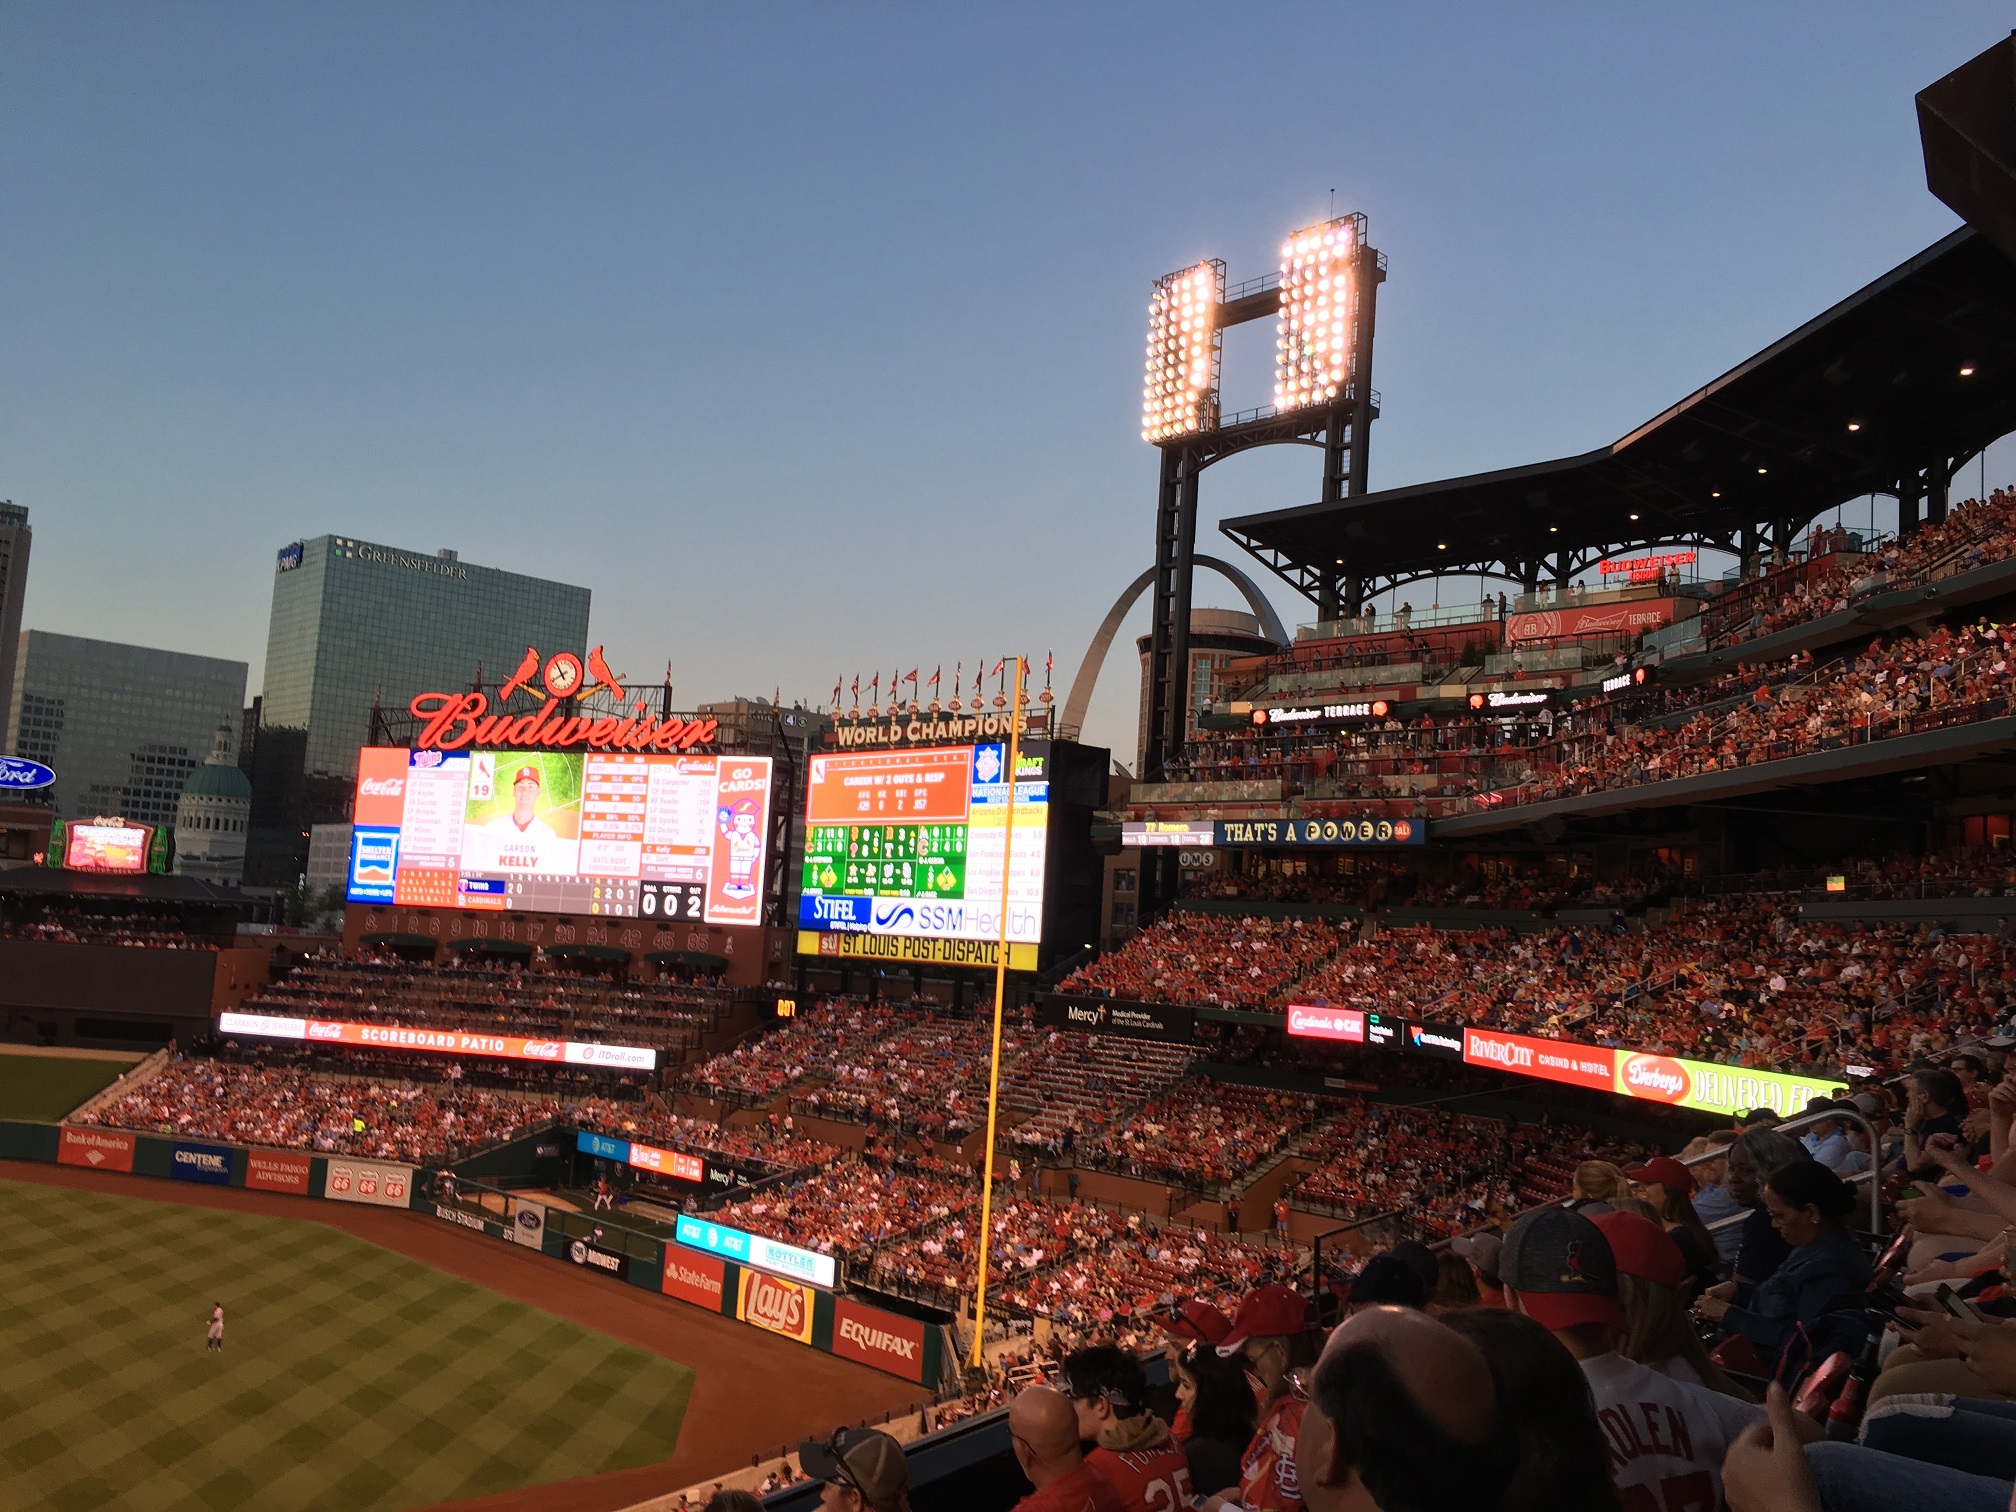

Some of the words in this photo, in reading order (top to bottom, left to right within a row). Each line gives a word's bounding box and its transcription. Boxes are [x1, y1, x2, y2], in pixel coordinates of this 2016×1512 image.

[1599, 551, 1696, 575] BUDWEISER
[1629, 611, 1661, 626] TERRACE
[1604, 672, 1631, 693] TERRACE
[1487, 691, 1548, 708] Budweiser
[1269, 706, 1322, 723] Budweiser
[1324, 703, 1370, 719] TERRACE
[409, 692, 718, 750] Budweiser
[838, 726, 902, 746] WORLD
[906, 715, 1028, 742] CHAMPIONS
[414, 750, 442, 768] Twins
[675, 757, 716, 774] Cardinals
[732, 768, 752, 779] GO
[1016, 766, 1043, 776] KINGS
[662, 779, 690, 787] Carpenter
[719, 779, 767, 793] CARDS!
[844, 776, 872, 786] CAREER
[874, 775, 884, 785] W/
[886, 775, 892, 784] 2
[893, 774, 914, 784] OUTS
[916, 774, 922, 783] &
[925, 773, 945, 783] RISP
[474, 784, 490, 796] 19
[858, 790, 870, 799] AVG
[914, 789, 927, 797] OPS
[972, 787, 1007, 797] NATIONA
[1014, 785, 1046, 796] LEAGUE
[857, 801, 870, 811] .429
[971, 807, 995, 816] Arizona
[997, 806, 1044, 816] Diaondbacks
[826, 828, 834, 838] 11
[1158, 822, 1190, 832] Romero
[1224, 822, 1277, 842] THAT'S
[1285, 823, 1297, 842] A
[1306, 822, 1391, 841] POWER
[970, 831, 996, 839] Colorado
[1032, 831, 1042, 839] 3.5
[1137, 835, 1147, 846] 10
[360, 846, 392, 855] SHELTER
[504, 844, 536, 853] CARSON
[656, 846, 671, 854] Kelly
[969, 850, 978, 858] San
[1030, 850, 1041, 858] 4.0
[499, 855, 539, 868] KELLY
[696, 869, 703, 880] 6
[967, 868, 976, 876] Los
[978, 868, 1000, 877] Angeles
[1029, 869, 1040, 877] 8.0
[469, 881, 489, 891] TWINS
[593, 887, 601, 899] 2
[604, 888, 612, 899] 2
[643, 884, 657, 892] BALL
[663, 885, 682, 894] STRIKE
[689, 886, 701, 894] OUT
[966, 887, 977, 895] San
[978, 887, 996, 897] Diego
[1026, 888, 1039, 896] 10.5
[400, 894, 451, 903] BASEBALL
[468, 896, 502, 906] CARDINALS
[642, 894, 657, 914] 0
[664, 895, 678, 915] 0
[687, 896, 701, 917] 2
[710, 904, 756, 915] Schnucks
[813, 896, 857, 921] STIFEL
[392, 915, 398, 932] 1
[408, 916, 419, 934] 2
[450, 918, 461, 937] 9
[472, 920, 488, 938] 10
[500, 921, 515, 940] 14
[527, 922, 543, 941] 17
[555, 925, 576, 944] 20
[586, 926, 608, 946] 24
[620, 928, 641, 948] 42
[653, 931, 675, 950] 45
[687, 933, 709, 952] 85
[843, 935, 859, 955] ST.
[862, 935, 899, 958] LOUIS
[903, 937, 1011, 965] POST-DISPATCH
[1068, 1005, 1099, 1026] Mercy
[1112, 1009, 1131, 1018] Medical
[1131, 1011, 1151, 1021] Provider
[1291, 1010, 1333, 1030] Cardinals
[226, 1018, 259, 1028] CLARKSON
[272, 1022, 303, 1032] JEWELERS
[1117, 1018, 1125, 1026] the
[1130, 1019, 1142, 1028] Louis
[1142, 1020, 1164, 1030] Cardinals
[361, 1028, 456, 1047] SCOREBOARD
[461, 1036, 505, 1052] PATIO
[598, 1050, 645, 1063] ITDroll.com
[1538, 1053, 1570, 1070] CASINO
[1571, 1058, 1578, 1071] &
[1580, 1061, 1610, 1077] HOTEL
[1627, 1061, 1685, 1095] Dierbergs
[1695, 1069, 1783, 1117] DELIVERED
[66, 1131, 86, 1146] Bank
[95, 1135, 129, 1151] America
[175, 1150, 225, 1168] CENTENE
[250, 1158, 277, 1172] WELLS
[279, 1162, 309, 1175] FARGO
[256, 1171, 300, 1185] ADVISORS
[709, 1167, 730, 1187] Mercy
[334, 1177, 349, 1188] 66
[359, 1180, 376, 1192] 66
[386, 1184, 404, 1195] 66
[436, 1205, 457, 1222] BUSCH
[456, 1210, 485, 1232] STADIUM
[723, 1233, 744, 1252] AT&T
[587, 1249, 620, 1272] MIDWEST
[766, 1246, 815, 1270] ROTTLER
[746, 1271, 803, 1330] Lay's
[839, 1316, 914, 1360] EQUIFAX
